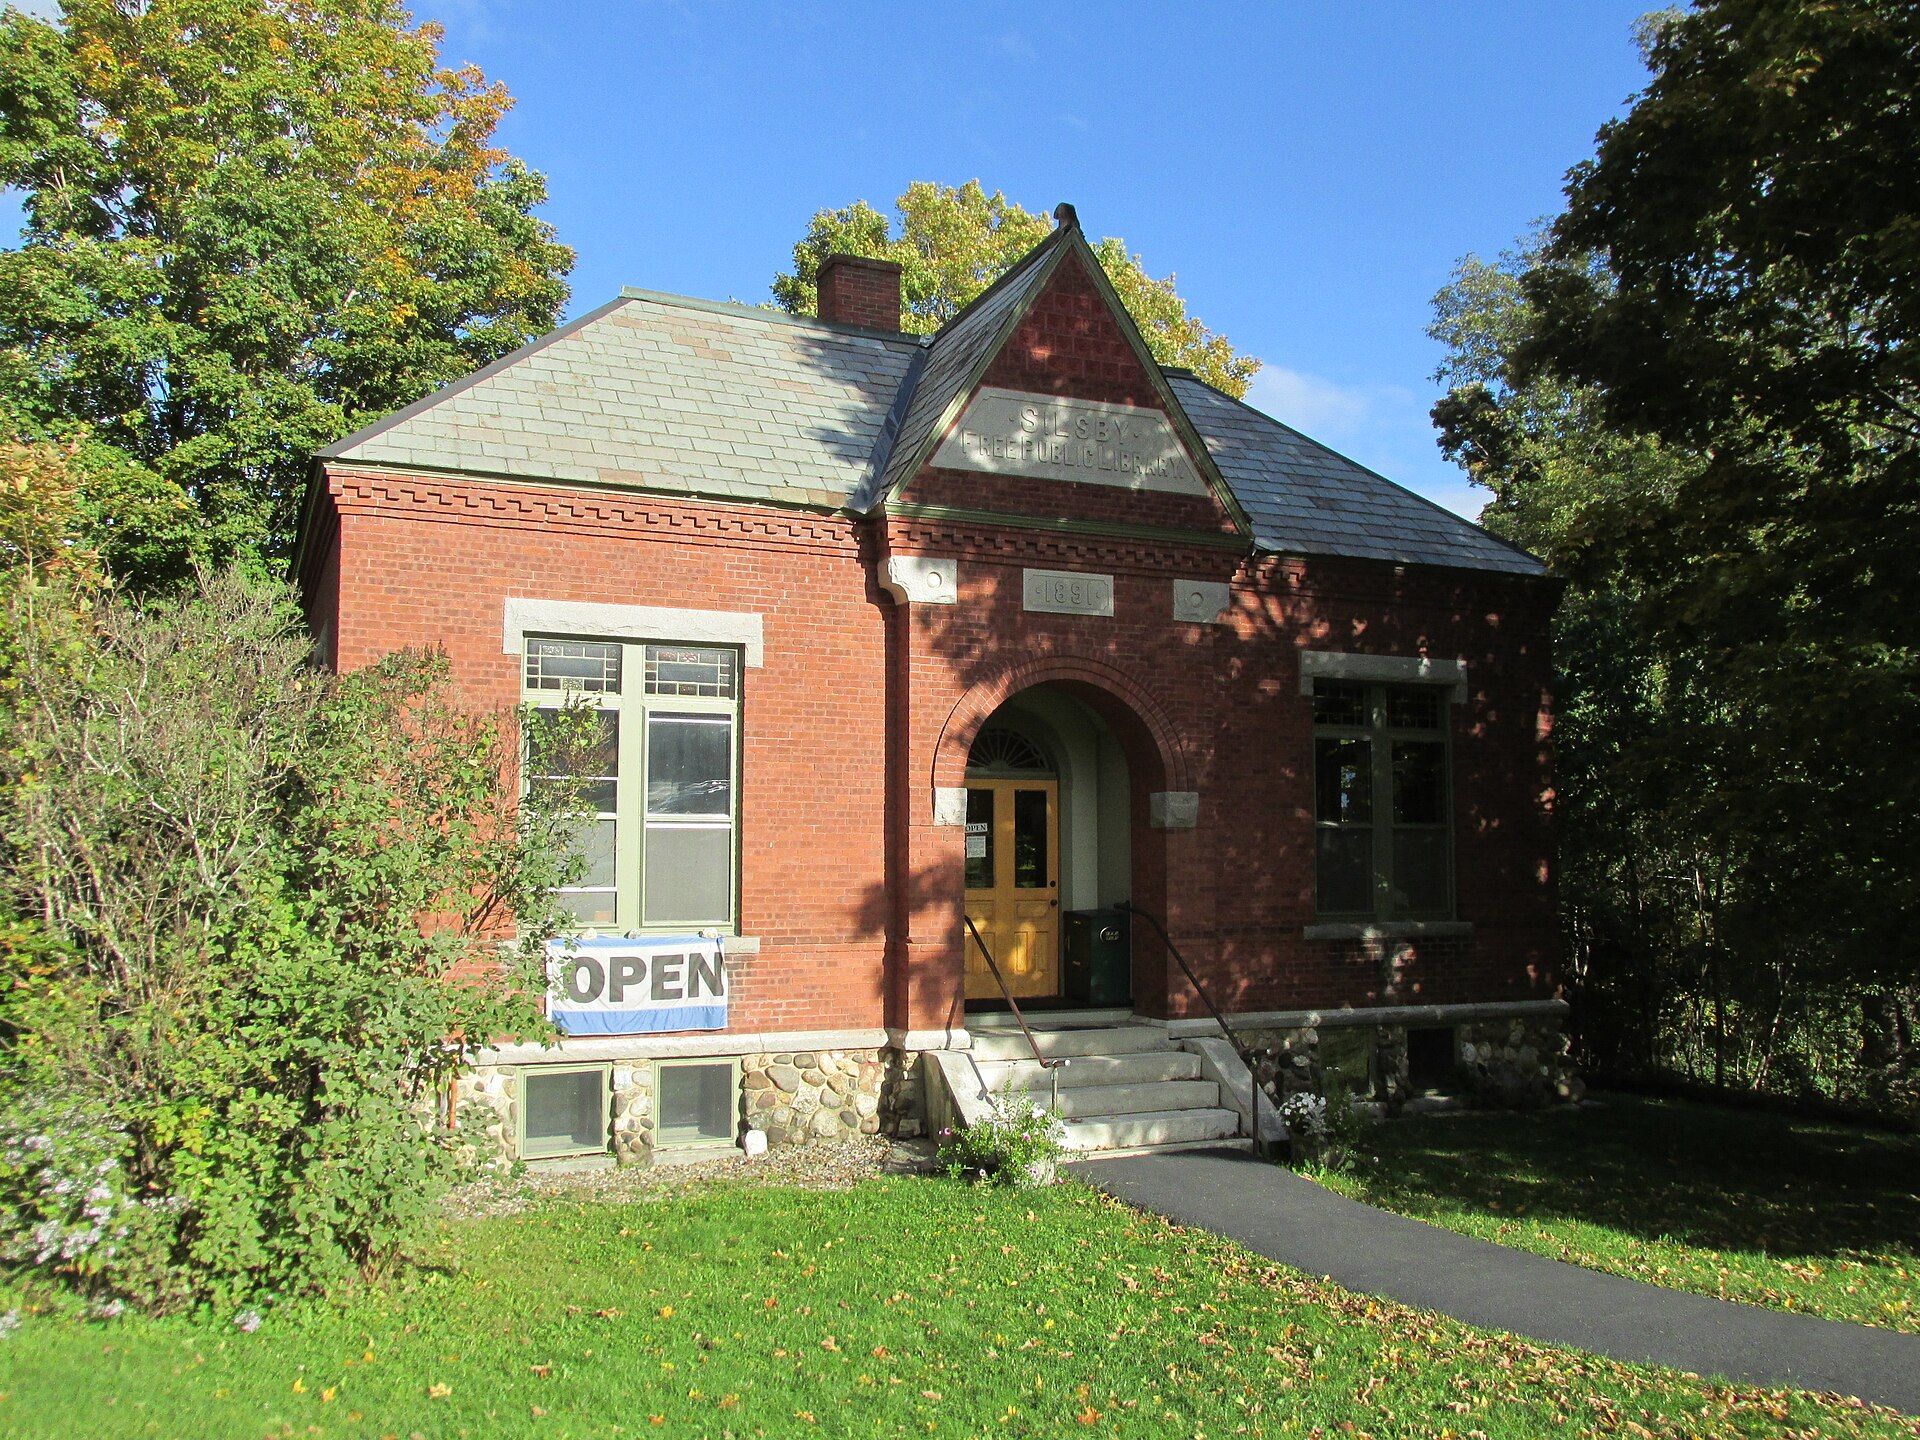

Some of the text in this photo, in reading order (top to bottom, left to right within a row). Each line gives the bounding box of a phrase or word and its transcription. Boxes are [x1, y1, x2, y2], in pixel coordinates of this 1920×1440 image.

[1019, 405, 1131, 446] SILSBY
[961, 428, 1184, 479] FREE PUBLIC LIBRARY
[1044, 579, 1093, 606] 1891
[562, 951, 725, 1004] OPEN
